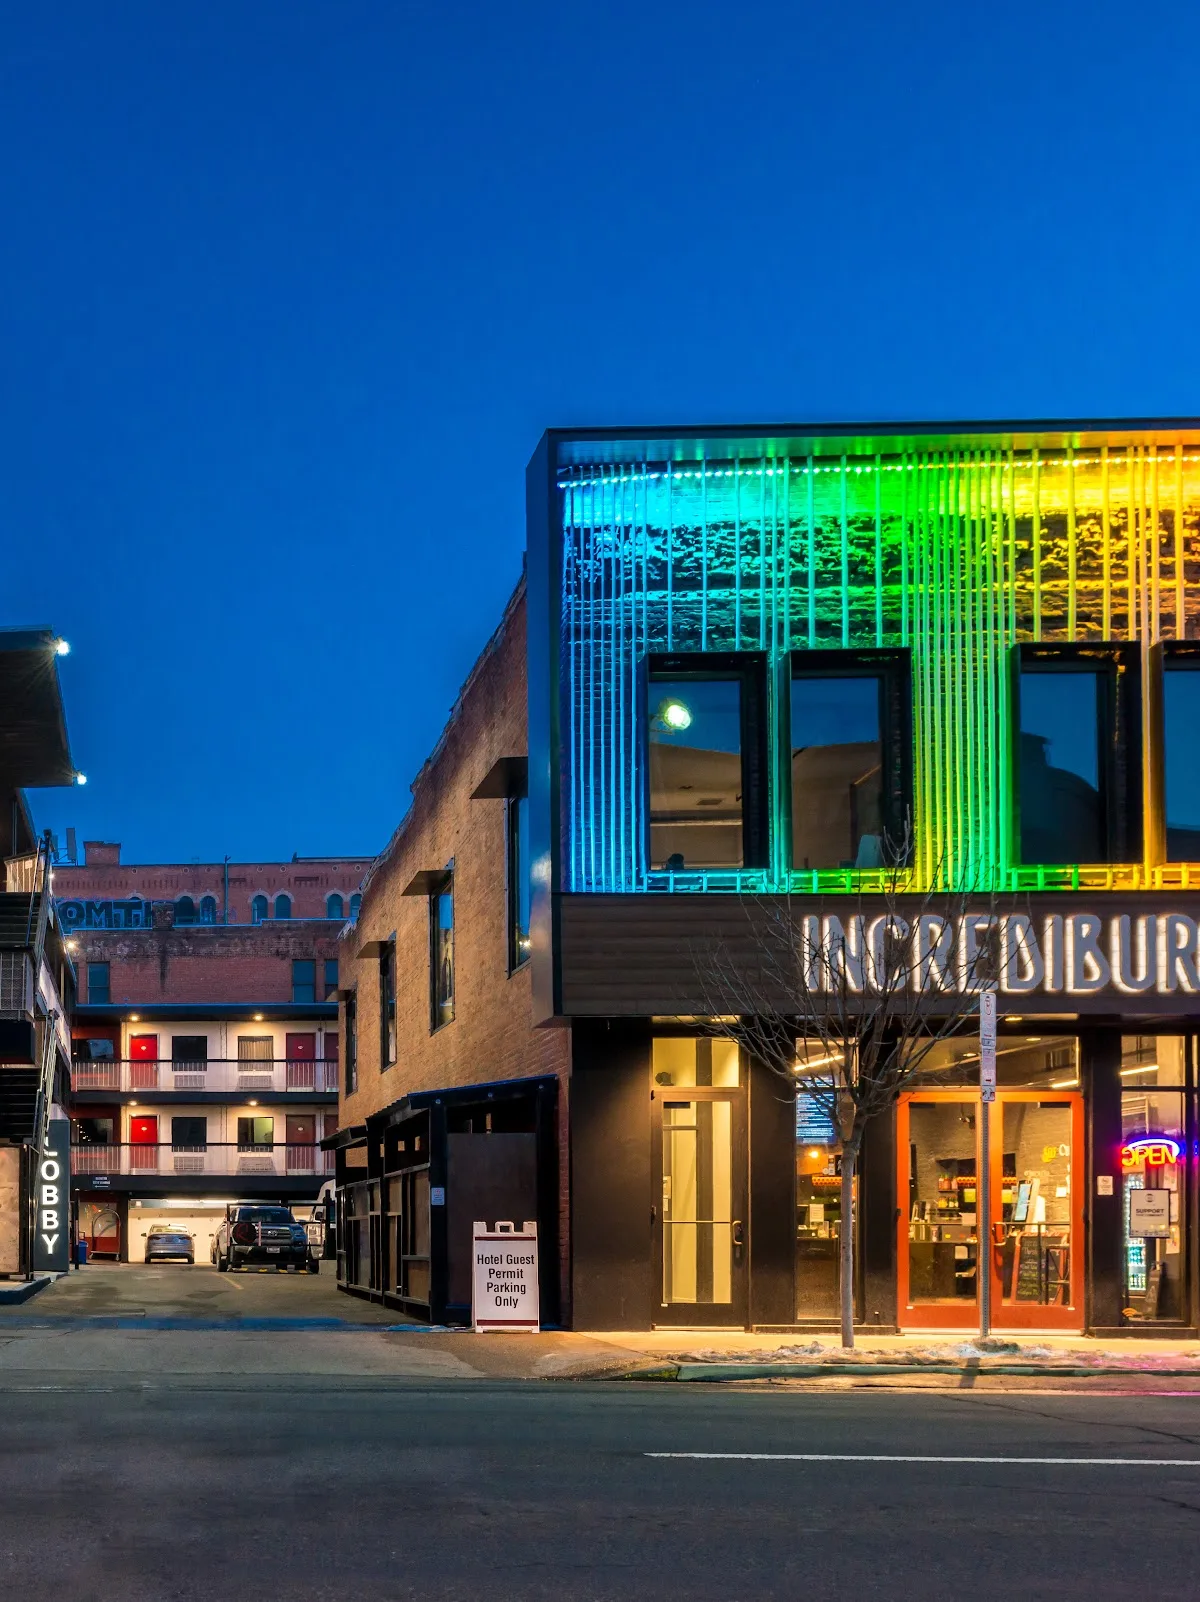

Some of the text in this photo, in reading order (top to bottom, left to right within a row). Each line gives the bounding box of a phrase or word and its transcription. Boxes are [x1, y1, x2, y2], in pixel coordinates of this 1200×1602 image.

[1121, 1145, 1177, 1167] OPEN
[477, 1254, 535, 1265] Hotel Guest
[488, 1268, 524, 1279] Permit
[486, 1282, 526, 1295] Parking
[495, 1295, 519, 1309] Only
